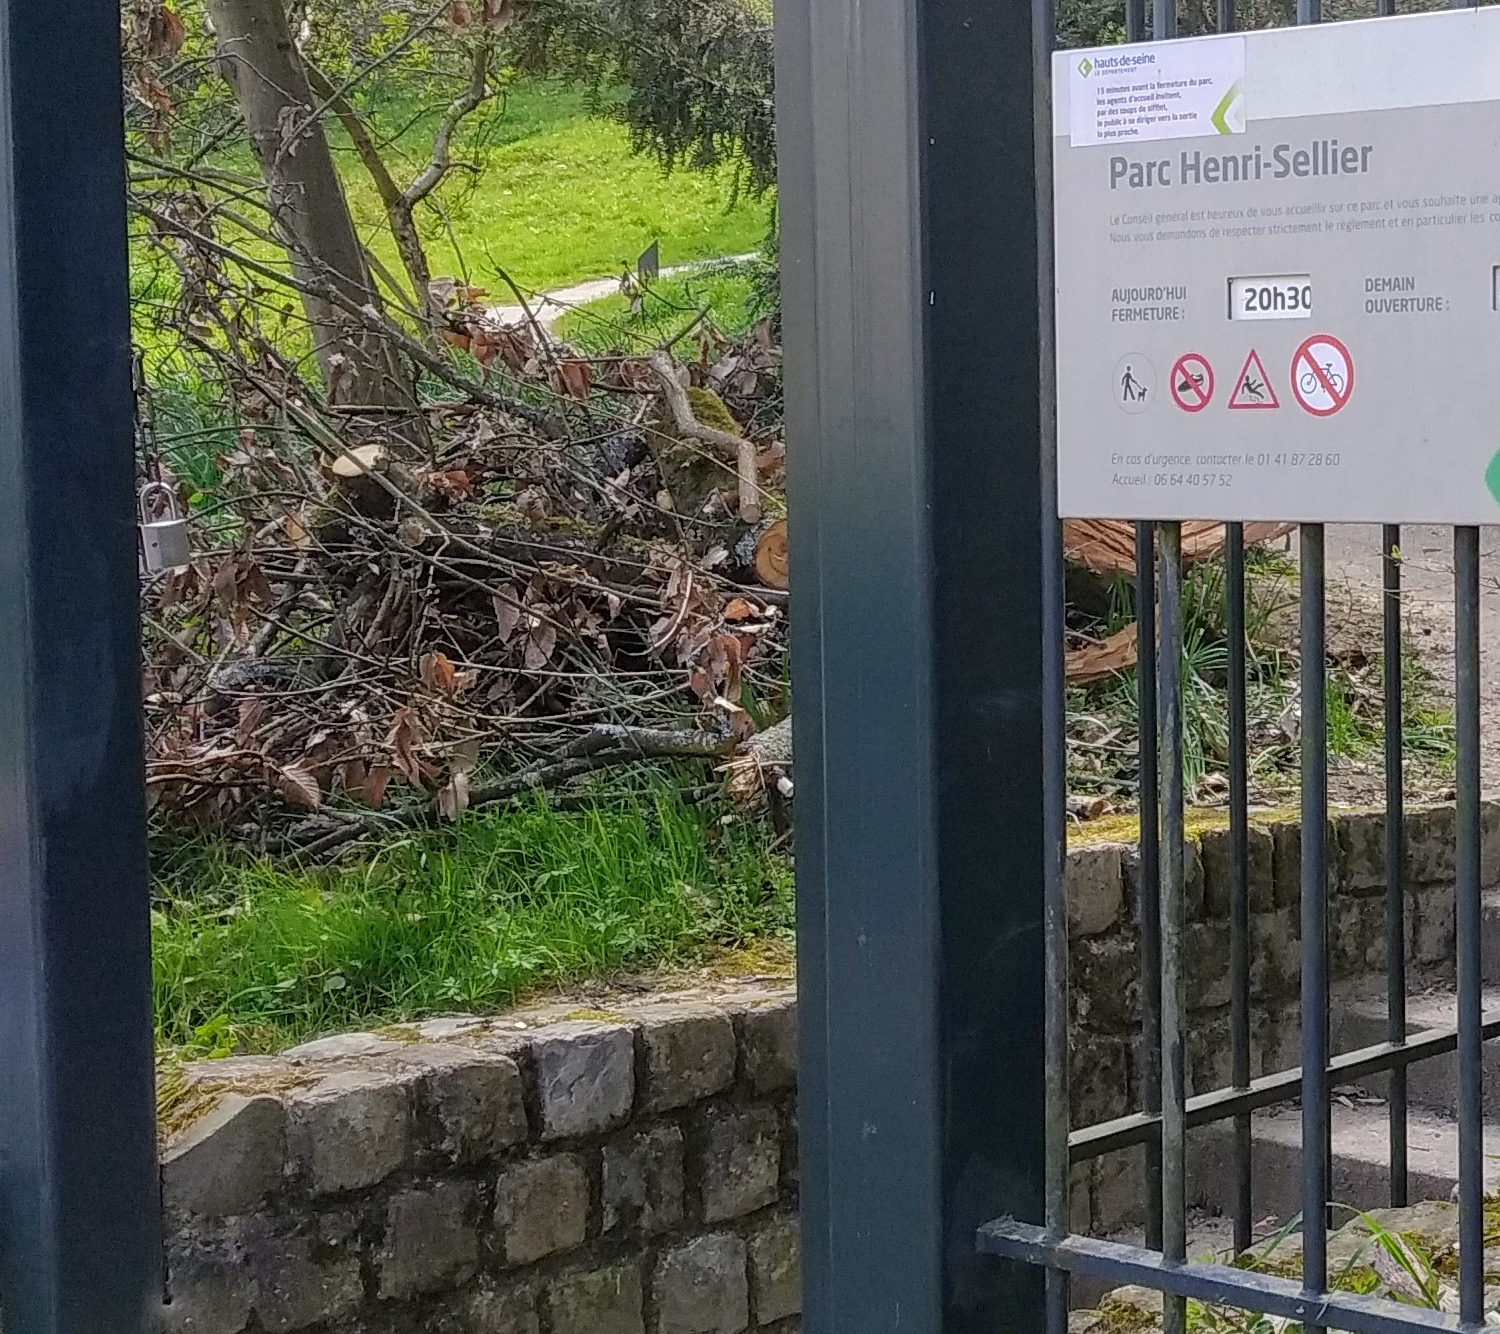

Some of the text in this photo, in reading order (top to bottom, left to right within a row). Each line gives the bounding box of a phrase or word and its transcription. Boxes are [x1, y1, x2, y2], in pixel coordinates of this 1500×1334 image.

[1094, 53, 1155, 68] hauts-de-seine
[1097, 87, 1105, 95] 15
[1106, 86, 1130, 94] minutes
[1132, 84, 1148, 92] avant
[1157, 80, 1187, 89] fermeture
[1189, 78, 1197, 86] du
[1097, 98, 1105, 106] les
[1107, 96, 1127, 106] agents
[1097, 110, 1107, 118] par
[1108, 107, 1119, 115] des
[1120, 107, 1137, 116] coups
[1104, 118, 1121, 127] public
[1136, 116, 1156, 125] diriger
[1158, 114, 1171, 122] vers
[1172, 113, 1178, 121] la
[1179, 111, 1197, 120] sortie
[1104, 129, 1116, 138] plus
[1110, 139, 1373, 189] Parc Henri-Sellier
[1110, 215, 1119, 226] Le
[1122, 213, 1152, 225] Conseil
[1190, 211, 1205, 221] est
[1207, 209, 1244, 220] heureux
[1247, 207, 1258, 218] de
[1261, 207, 1282, 217] vous
[1285, 203, 1326, 215] accueillir
[1329, 204, 1343, 213] sur
[1347, 202, 1357, 212] ce
[1360, 201, 1381, 213] parc
[1384, 199, 1393, 210] et
[1397, 199, 1420, 208] vous
[1423, 195, 1467, 208] souhaite
[1470, 195, 1489, 205] une
[1109, 233, 1131, 243] Nous
[1133, 232, 1154, 242] vous
[1156, 229, 1207, 240] demandons
[1209, 228, 1220, 237] de
[1222, 227, 1266, 239] respecter
[1268, 222, 1322, 235] strictement
[1325, 221, 1333, 231] le
[1388, 218, 1398, 228] et
[1401, 218, 1414, 227] en
[1416, 213, 1467, 229] particulier
[1470, 212, 1485, 223] les
[1365, 277, 1415, 293] DEMAIN
[1112, 286, 1187, 305] AUJOURD'HUI
[1244, 286, 1311, 312] 20h30
[1365, 297, 1443, 314] OUVERTURE
[1112, 306, 1179, 322] FERMETURE
[1111, 452, 1123, 465] En
[1126, 455, 1141, 465] cas
[1196, 454, 1242, 465] contacter
[1245, 453, 1254, 465] le
[1257, 453, 1270, 466] 01
[1274, 453, 1287, 466] 41
[1291, 453, 1305, 466] 87
[1308, 453, 1323, 466] 28
[1325, 453, 1340, 466] 60
[1112, 473, 1146, 486] Accueil
[1154, 473, 1167, 486] 06
[1170, 473, 1183, 486] 64
[1186, 473, 1200, 486] 40
[1203, 474, 1216, 486] 57
[1219, 474, 1233, 487] 52
